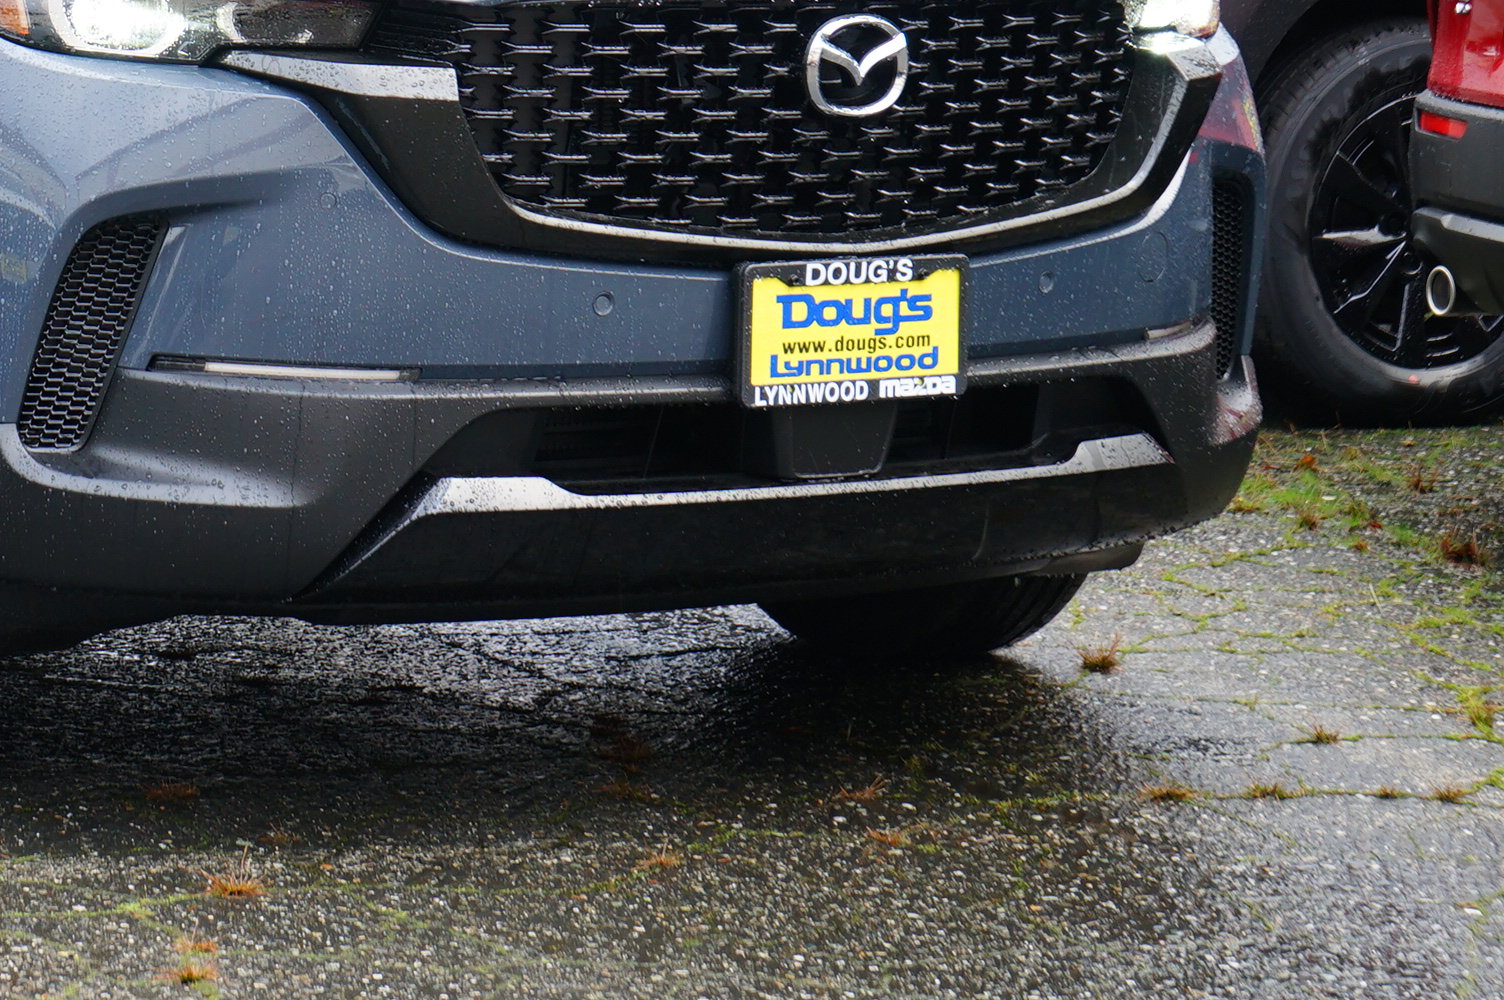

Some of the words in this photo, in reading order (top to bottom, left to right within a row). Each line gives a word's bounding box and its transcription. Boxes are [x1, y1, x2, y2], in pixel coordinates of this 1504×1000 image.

[805, 258, 914, 287] DOUG'S
[776, 288, 934, 336] Doug's
[782, 333, 931, 355] www.dougs.com
[770, 346, 939, 378] Lynnwood
[754, 379, 870, 407] LYNNWOOD
